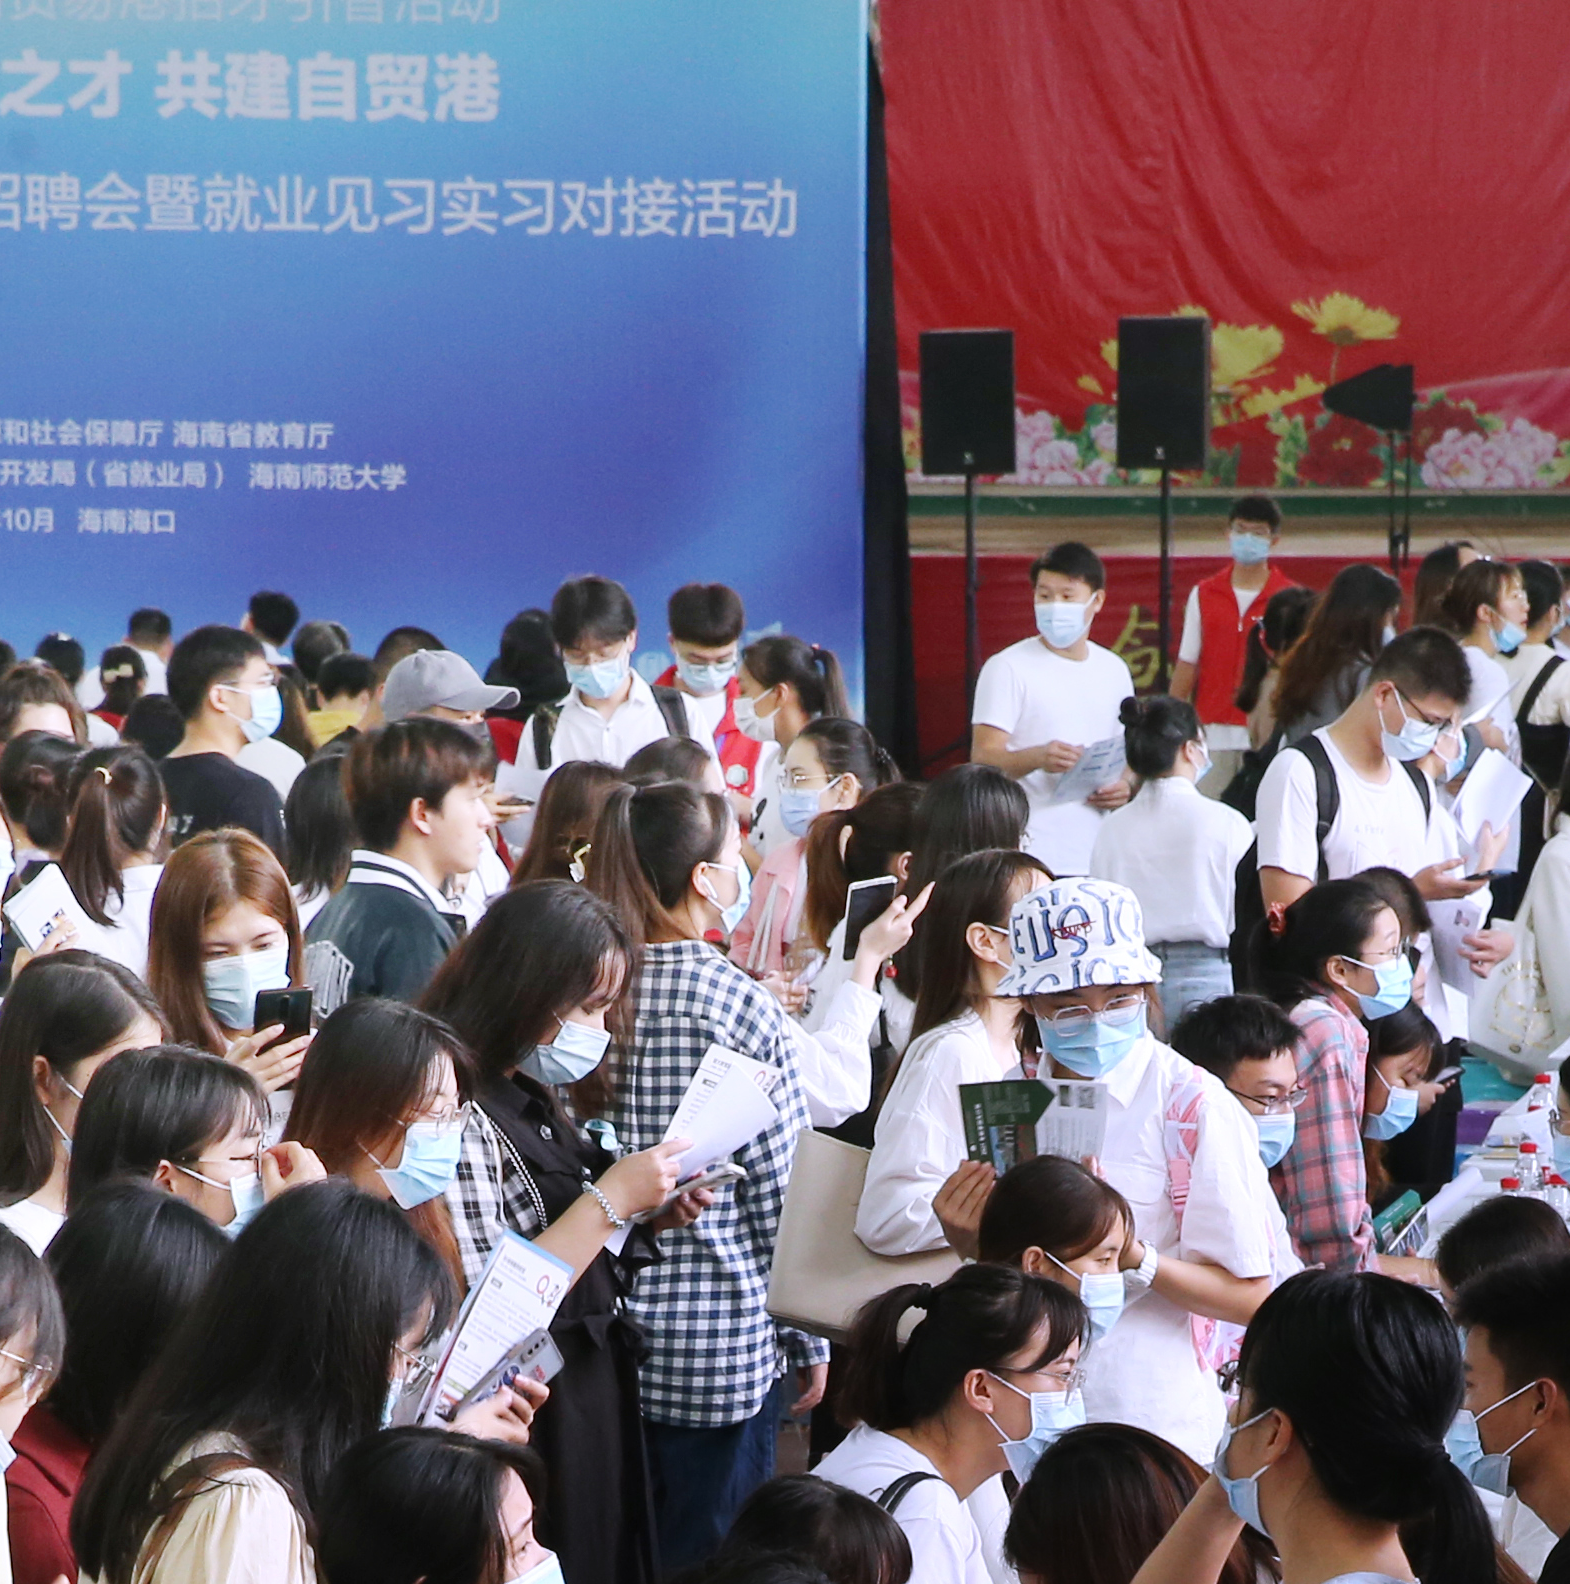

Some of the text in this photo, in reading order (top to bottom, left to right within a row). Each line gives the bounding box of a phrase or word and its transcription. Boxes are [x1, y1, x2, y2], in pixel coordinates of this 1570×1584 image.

[154, 49, 501, 123] 共建自贸港
[173, 420, 334, 450] 海南省教育厅
[249, 462, 408, 492] 海南师范大学
[77, 508, 176, 534] 海南海口
